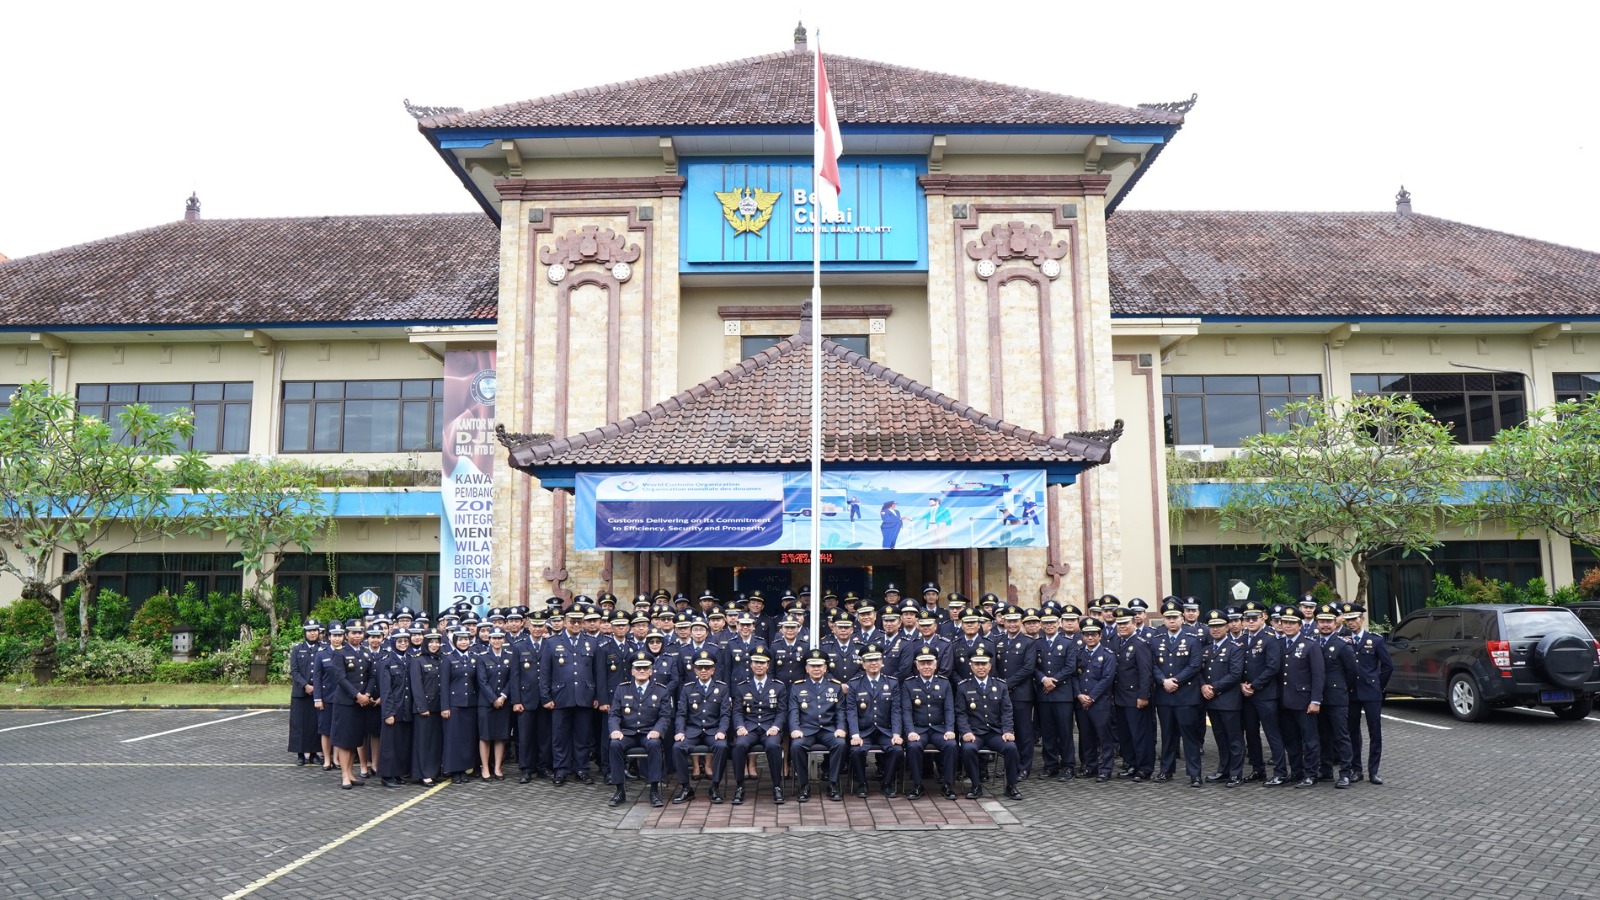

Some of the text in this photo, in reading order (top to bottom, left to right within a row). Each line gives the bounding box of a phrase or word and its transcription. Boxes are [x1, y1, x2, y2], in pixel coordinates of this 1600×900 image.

[830, 226, 853, 234] BALI,
[853, 226, 873, 234] NTB,
[456, 418, 486, 430] KANTOR
[646, 517, 689, 525] Delivering
